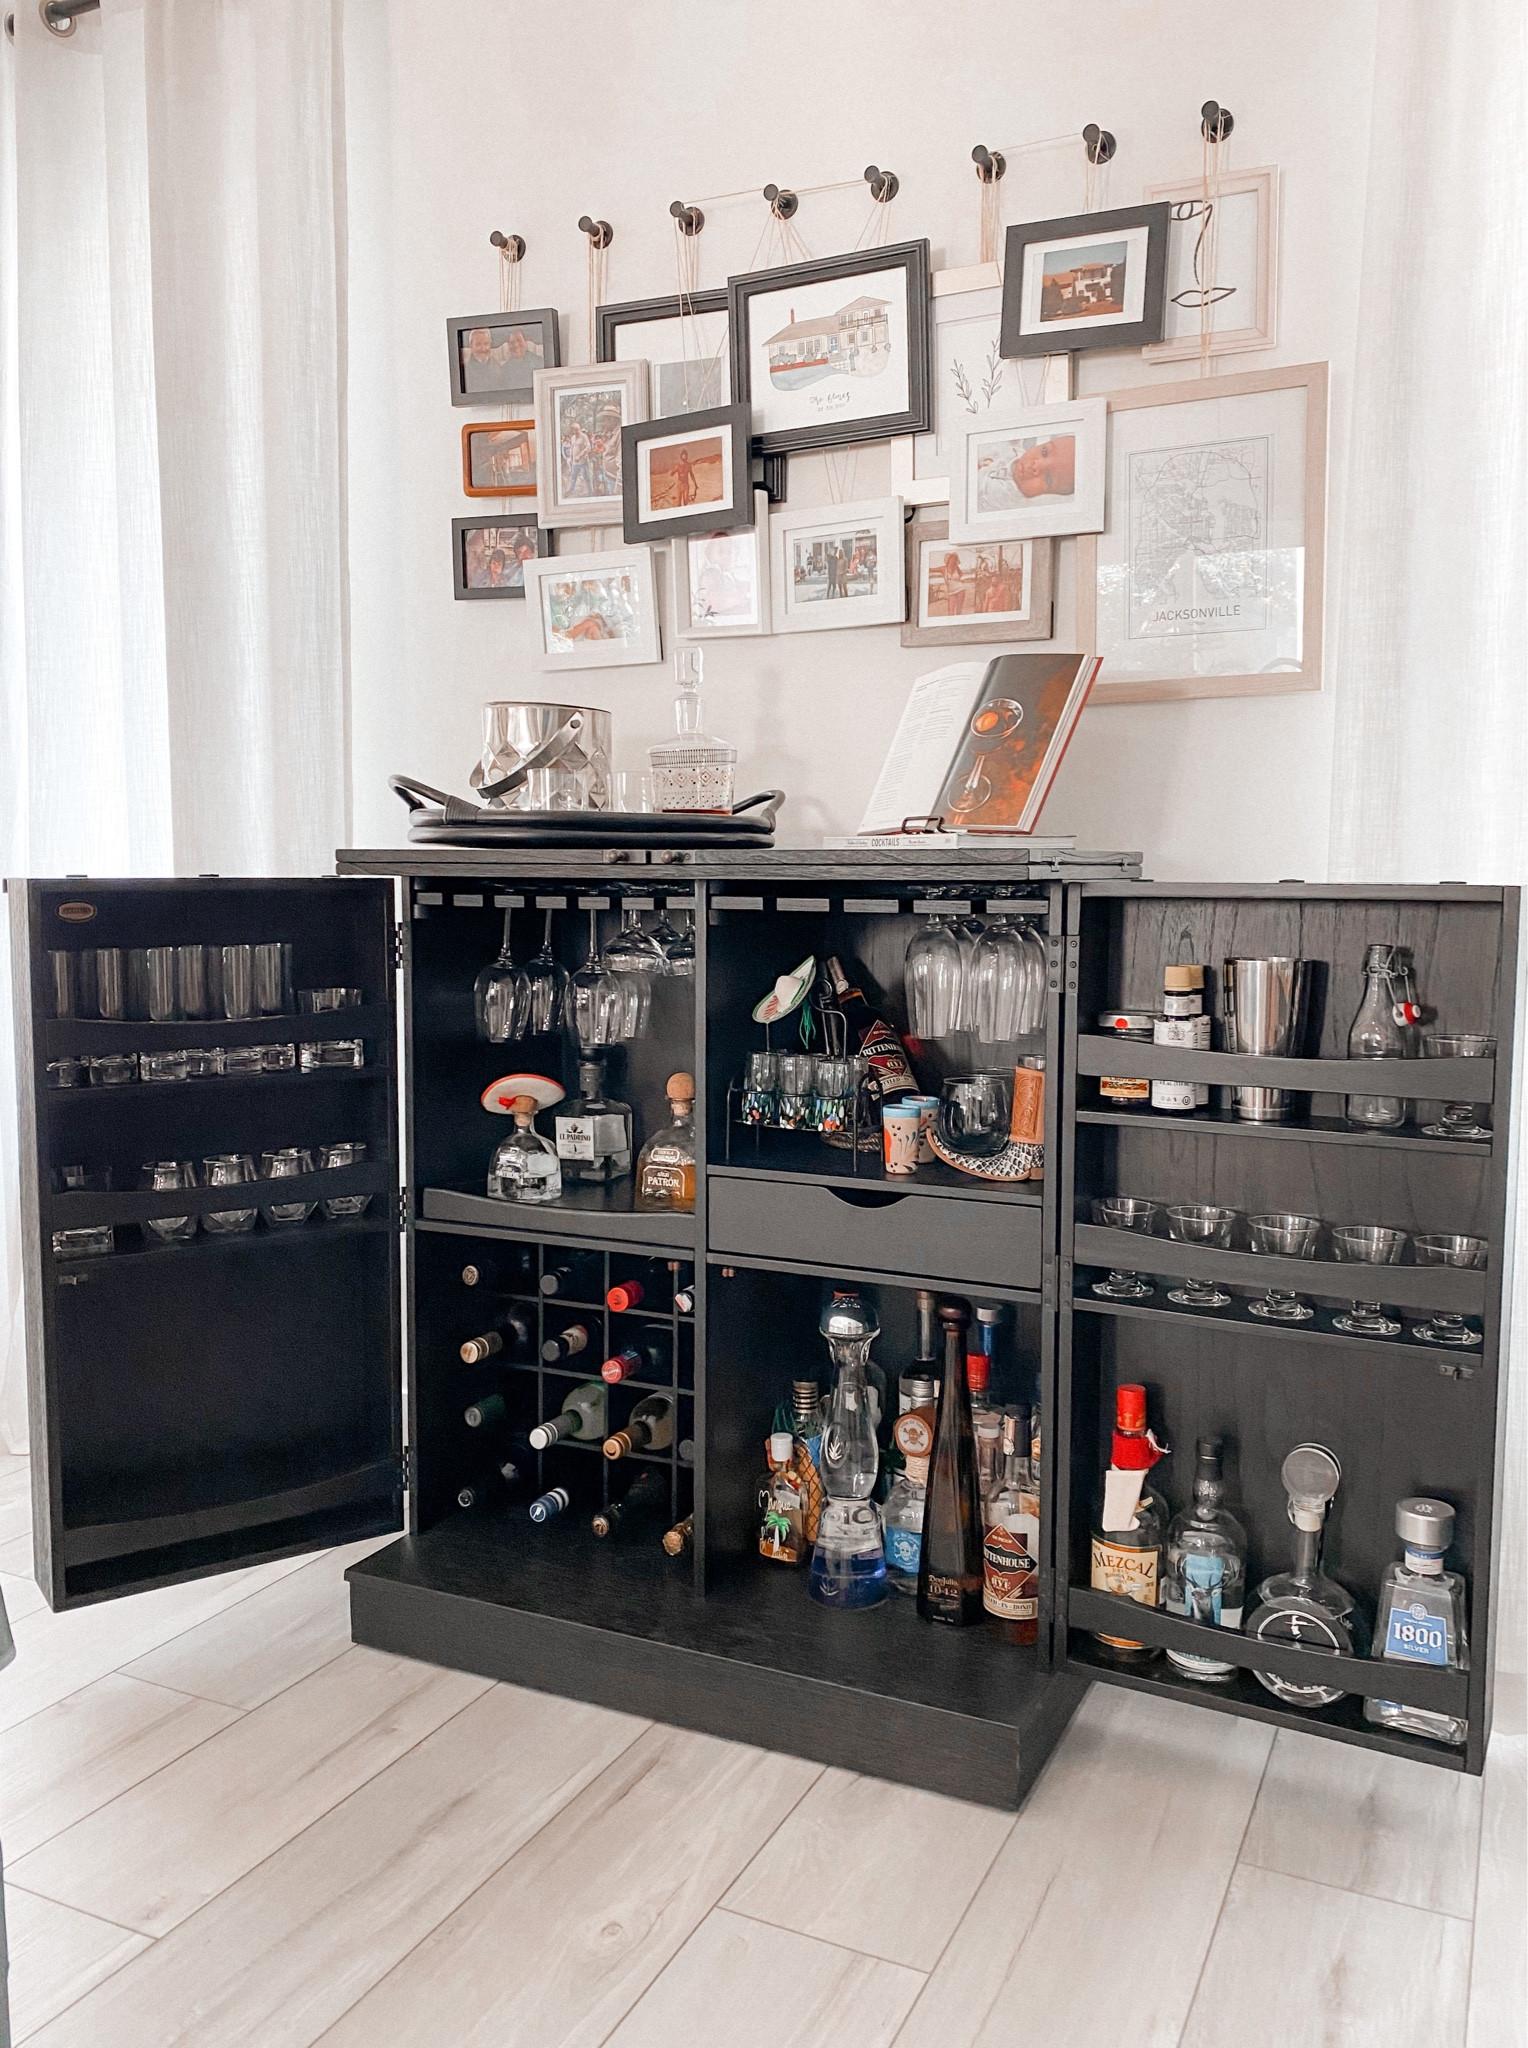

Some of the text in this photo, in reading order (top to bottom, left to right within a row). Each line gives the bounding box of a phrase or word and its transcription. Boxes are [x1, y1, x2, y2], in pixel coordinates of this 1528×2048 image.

[1152, 605, 1240, 622] JACKSONVILLE
[871, 838, 900, 847] COCKTAILS
[1093, 1551, 1155, 1579] MEZCAL
[991, 1576, 1011, 1589] RYE
[1393, 1622, 1442, 1648] 1800
[1403, 1643, 1430, 1655] SILVER
